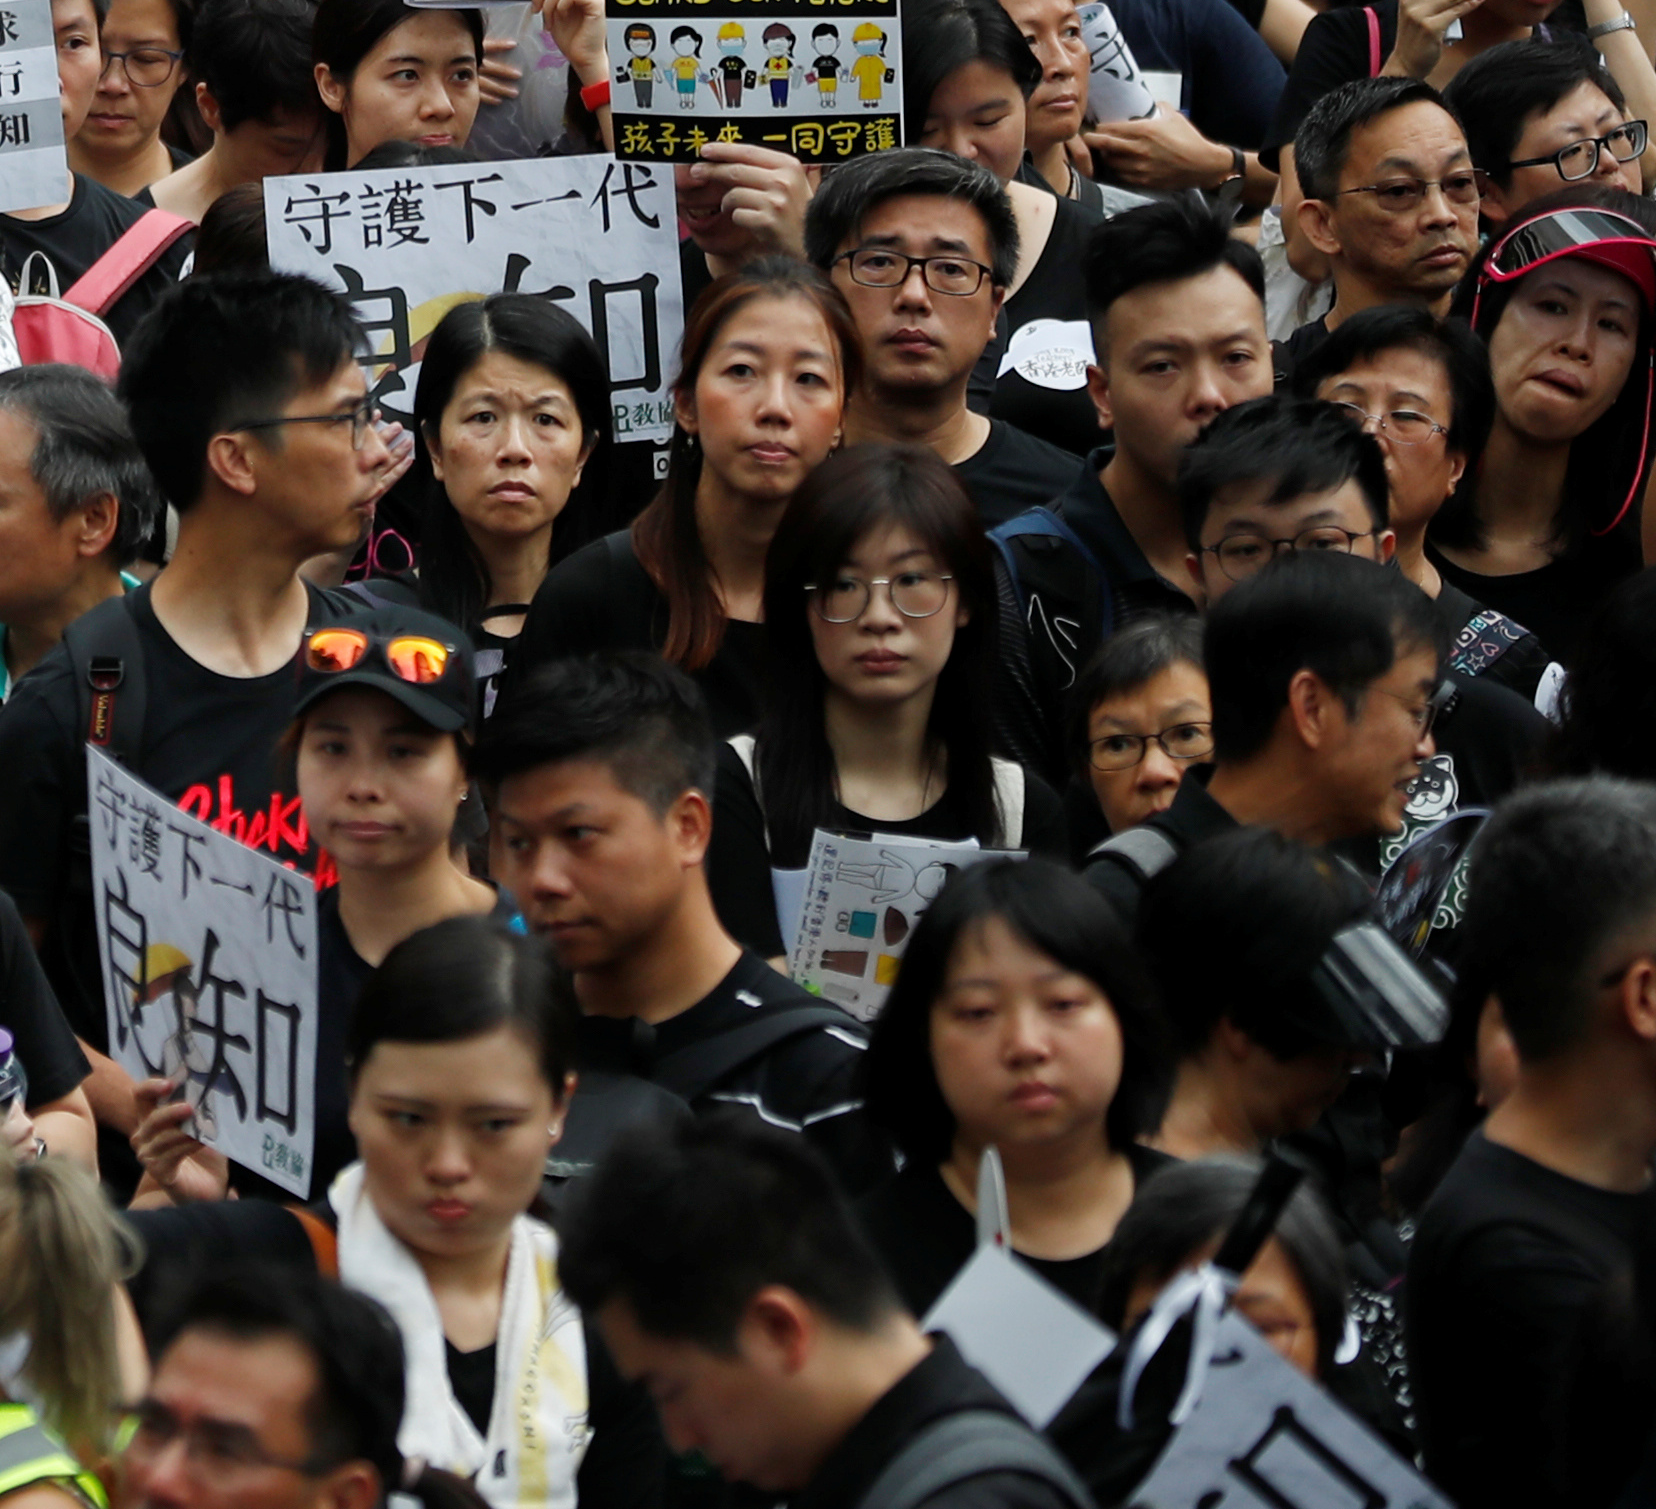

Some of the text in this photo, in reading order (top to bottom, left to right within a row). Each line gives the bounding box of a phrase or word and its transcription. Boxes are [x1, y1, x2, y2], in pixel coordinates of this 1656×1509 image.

[282, 160, 662, 256] 守護下一代
[621, 118, 898, 158] 孩子未來 一同守護
[94, 768, 307, 961] 守護下一代
[103, 865, 302, 1140] 良知
